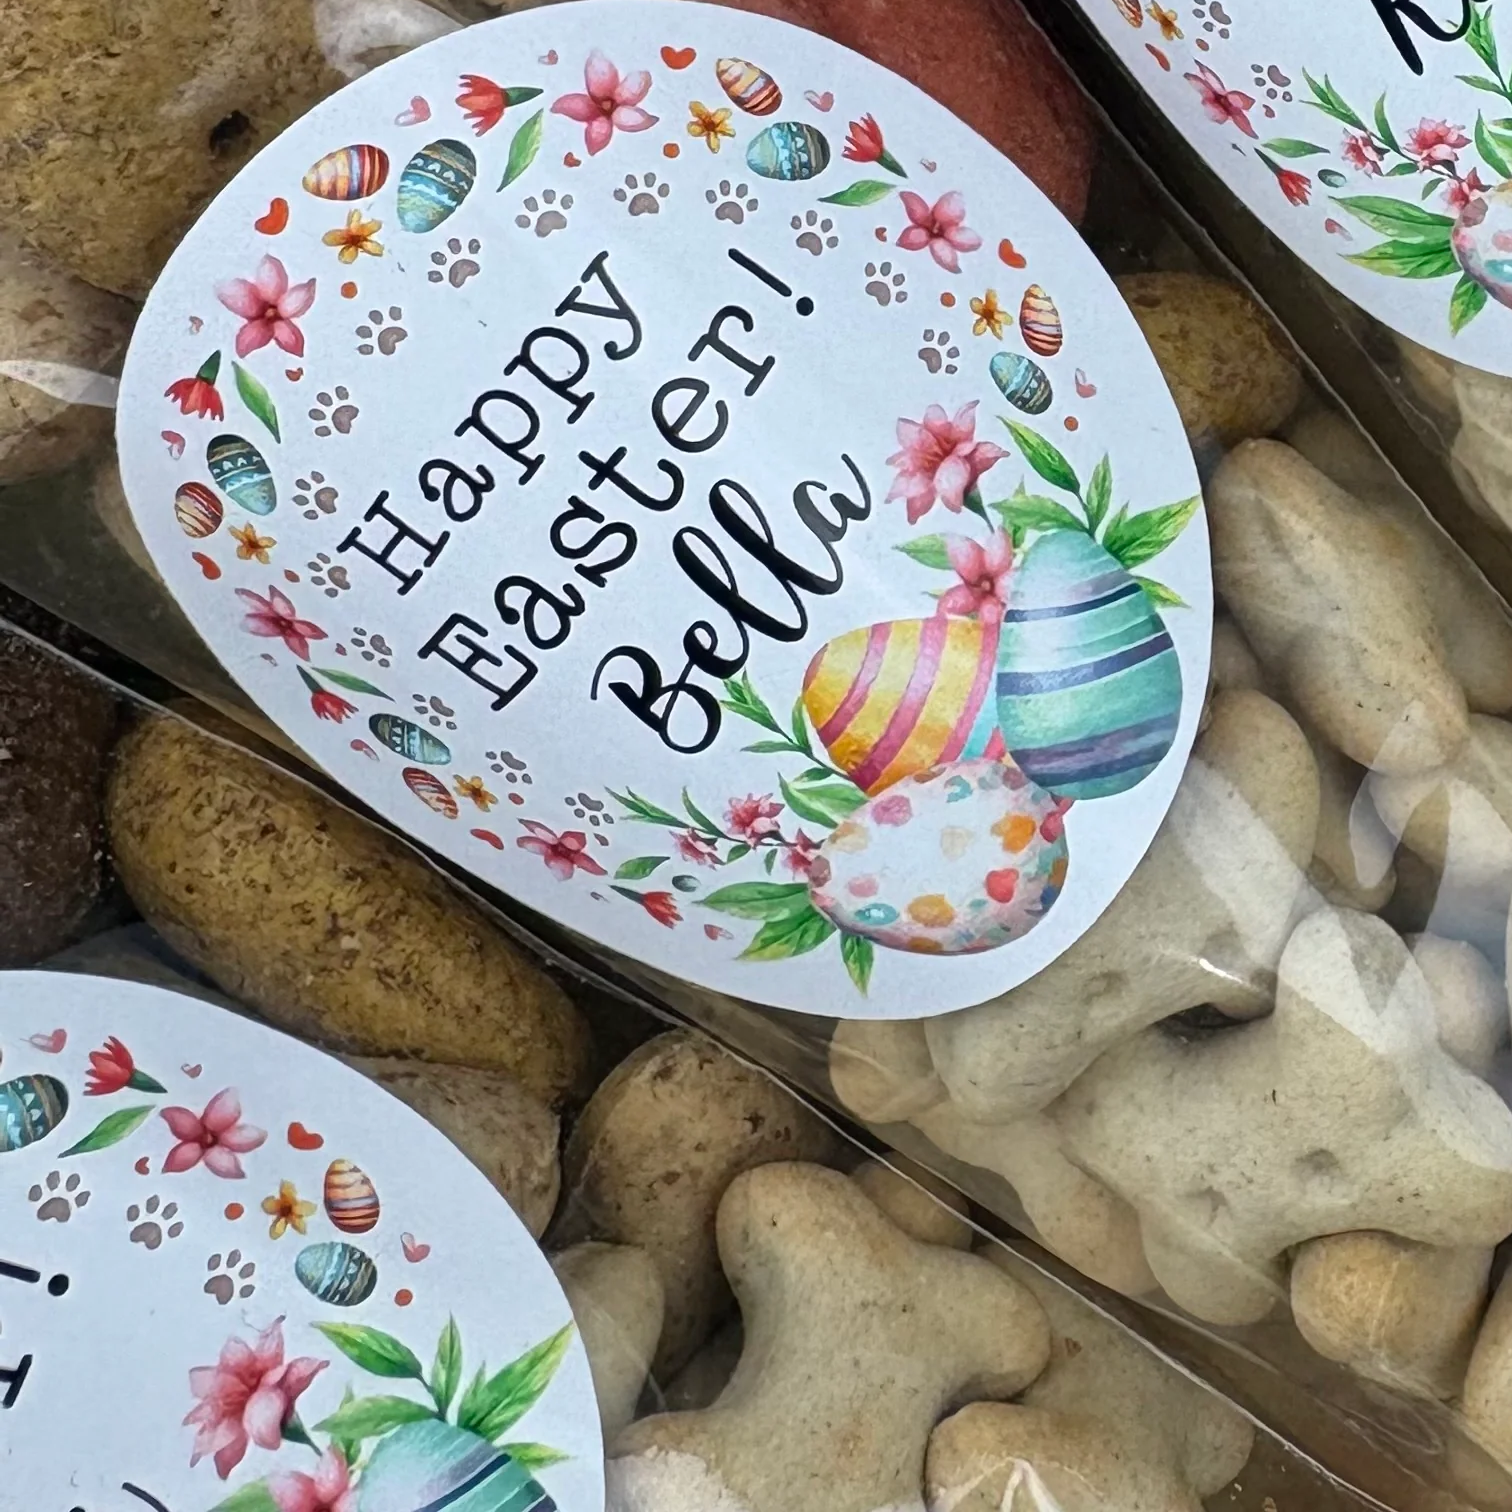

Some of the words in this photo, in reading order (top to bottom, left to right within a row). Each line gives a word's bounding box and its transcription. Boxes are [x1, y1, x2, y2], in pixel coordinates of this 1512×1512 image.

[335, 249, 643, 597] Happy
[416, 247, 815, 713] Easter!
[589, 452, 874, 755] Bella
